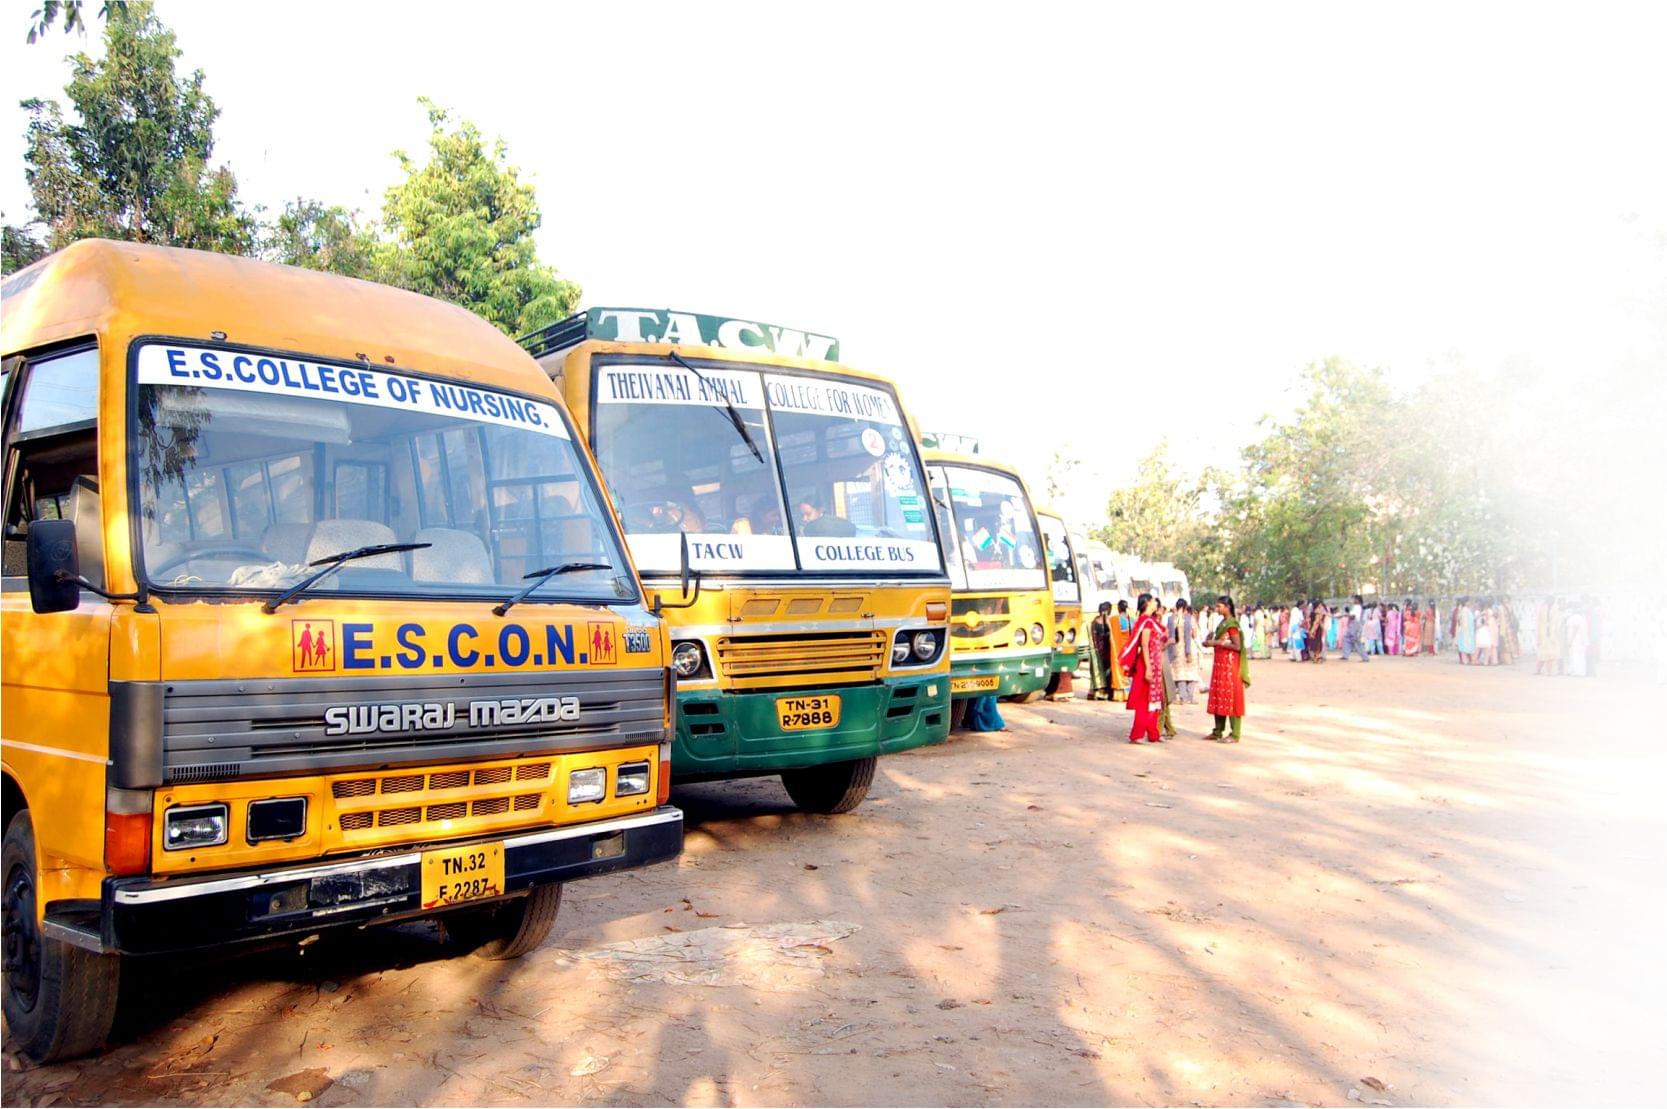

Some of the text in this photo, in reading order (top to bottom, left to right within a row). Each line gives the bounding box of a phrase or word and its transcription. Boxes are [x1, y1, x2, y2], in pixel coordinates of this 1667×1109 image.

[167, 350, 550, 428] E.S.COLLEGE OF NURSING.
[607, 373, 692, 400] THEIVANAI
[766, 382, 825, 411] COLLEGE
[826, 388, 852, 414] FOR
[869, 432, 879, 449] 2
[692, 542, 914, 562] TACW COLLEGE BUS
[342, 623, 588, 669] E.S.C.O.N.
[785, 699, 828, 711] TN-31
[442, 853, 485, 875] TN.32
